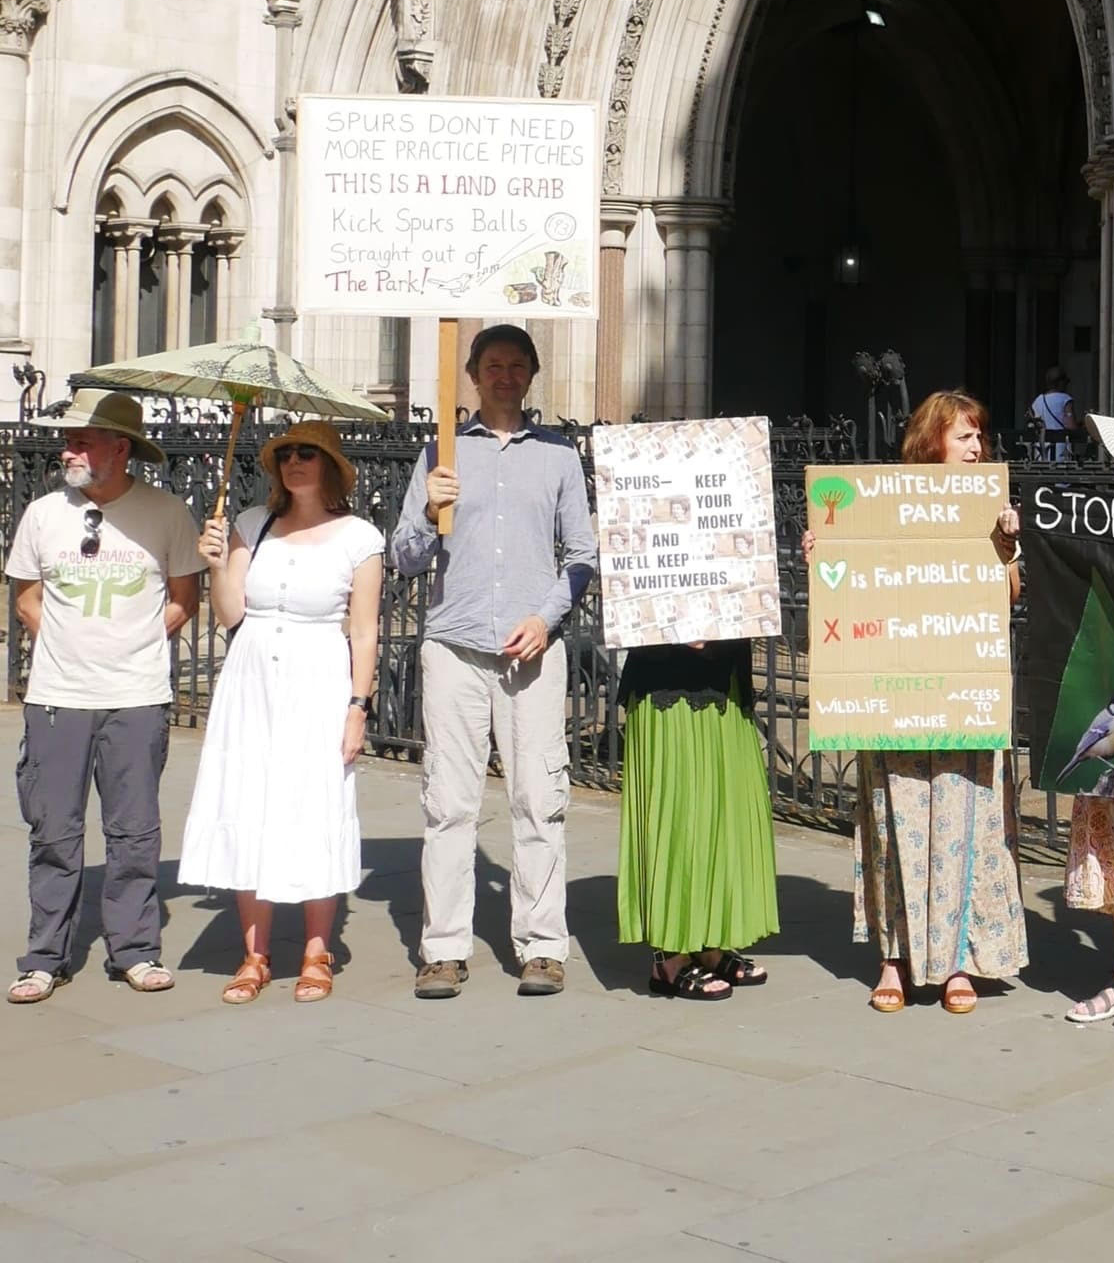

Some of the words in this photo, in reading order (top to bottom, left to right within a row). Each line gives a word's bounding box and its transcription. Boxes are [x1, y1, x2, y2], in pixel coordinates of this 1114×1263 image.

[326, 111, 415, 134] SPURS
[428, 113, 500, 136] DON'T
[510, 118, 575, 141] NEED
[324, 139, 387, 162] MORE
[395, 140, 489, 162] PRACTICE
[501, 143, 585, 166] PITCHES
[325, 173, 383, 194] THIS
[389, 173, 409, 194] IS
[415, 174, 431, 194] A
[440, 174, 497, 197] LAND
[506, 176, 565, 200] GRAB
[331, 208, 384, 234] Kick
[396, 207, 454, 243] Spurs
[471, 208, 528, 234] Balls
[330, 242, 412, 269] Straight
[421, 245, 456, 264] out
[465, 243, 488, 269] of
[325, 269, 368, 293] The
[375, 267, 431, 295] Park!
[695, 473, 727, 489] KEEP
[696, 493, 732, 509] YOUR
[697, 514, 743, 530] MONEY
[899, 503, 961, 526] PARK
[652, 533, 679, 548] AND
[612, 555, 650, 571] WE'LL
[657, 553, 689, 569] KEEP
[633, 571, 728, 590] WHITEWEBBS
[853, 618, 885, 640] NOT
[872, 675, 946, 692] PROTECT
[947, 689, 1000, 702] ACCESS
[973, 700, 992, 713] TO
[893, 714, 948, 730] NATURE
[964, 714, 996, 728] ALL
